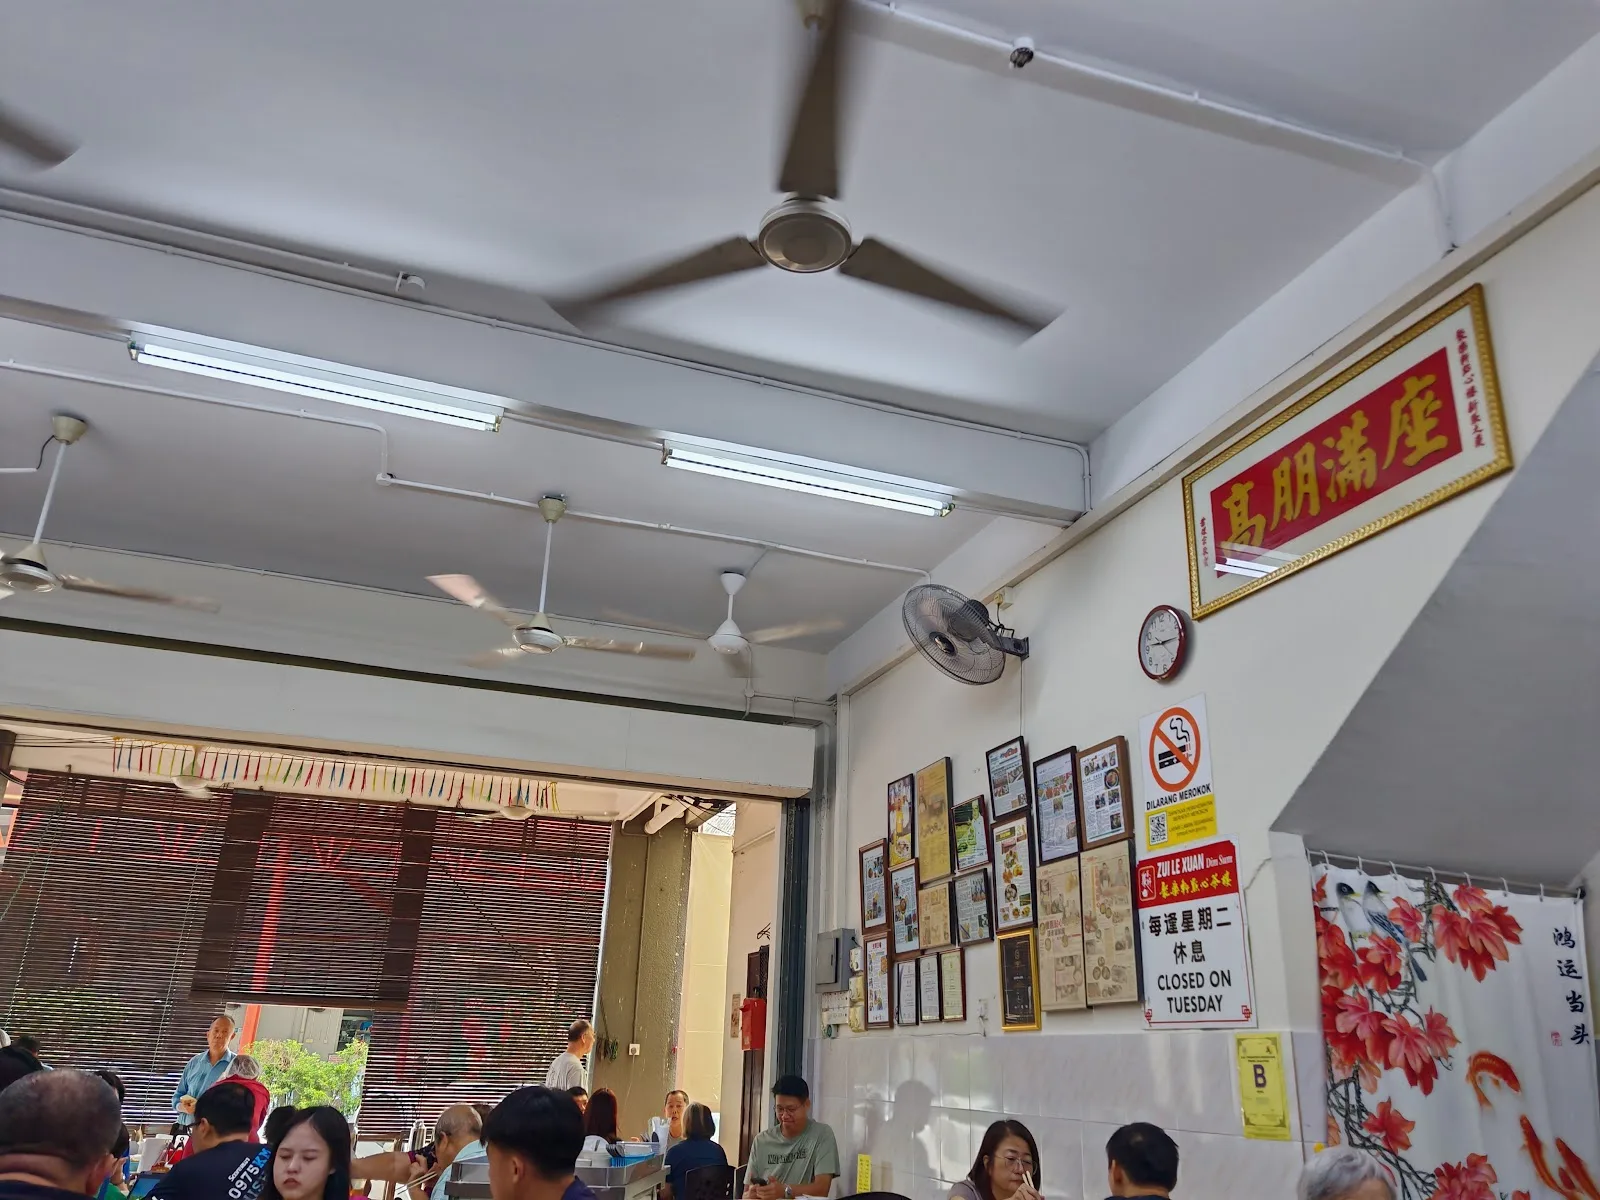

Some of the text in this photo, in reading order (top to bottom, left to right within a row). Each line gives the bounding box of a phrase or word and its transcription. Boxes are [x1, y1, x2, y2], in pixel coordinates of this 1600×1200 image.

[1220, 374, 1449, 556] 高朋滿座
[1151, 621, 1157, 630] 11
[1158, 613, 1165, 622] 12
[1145, 646, 1150, 655] 9
[1148, 656, 1153, 666] 8
[1154, 663, 1159, 673] 7
[1162, 664, 1168, 673] 6
[1146, 783, 1212, 811] DILARANG MEROKOK
[1156, 861, 1170, 879] ZUI
[1171, 858, 1181, 876] LE
[1181, 853, 1205, 874] XUAN
[1206, 857, 1218, 869] Dim
[1218, 854, 1233, 866] Sum
[1148, 906, 1232, 937] 每逢星期二
[1173, 940, 1206, 965] 休息
[1157, 969, 1232, 991] CLOSED ON
[1552, 926, 1590, 1046] 鸿运当头
[1167, 994, 1223, 1014] TUESDAY
[1253, 1064, 1267, 1088] B
[228, 1147, 272, 1199] 0975KM
